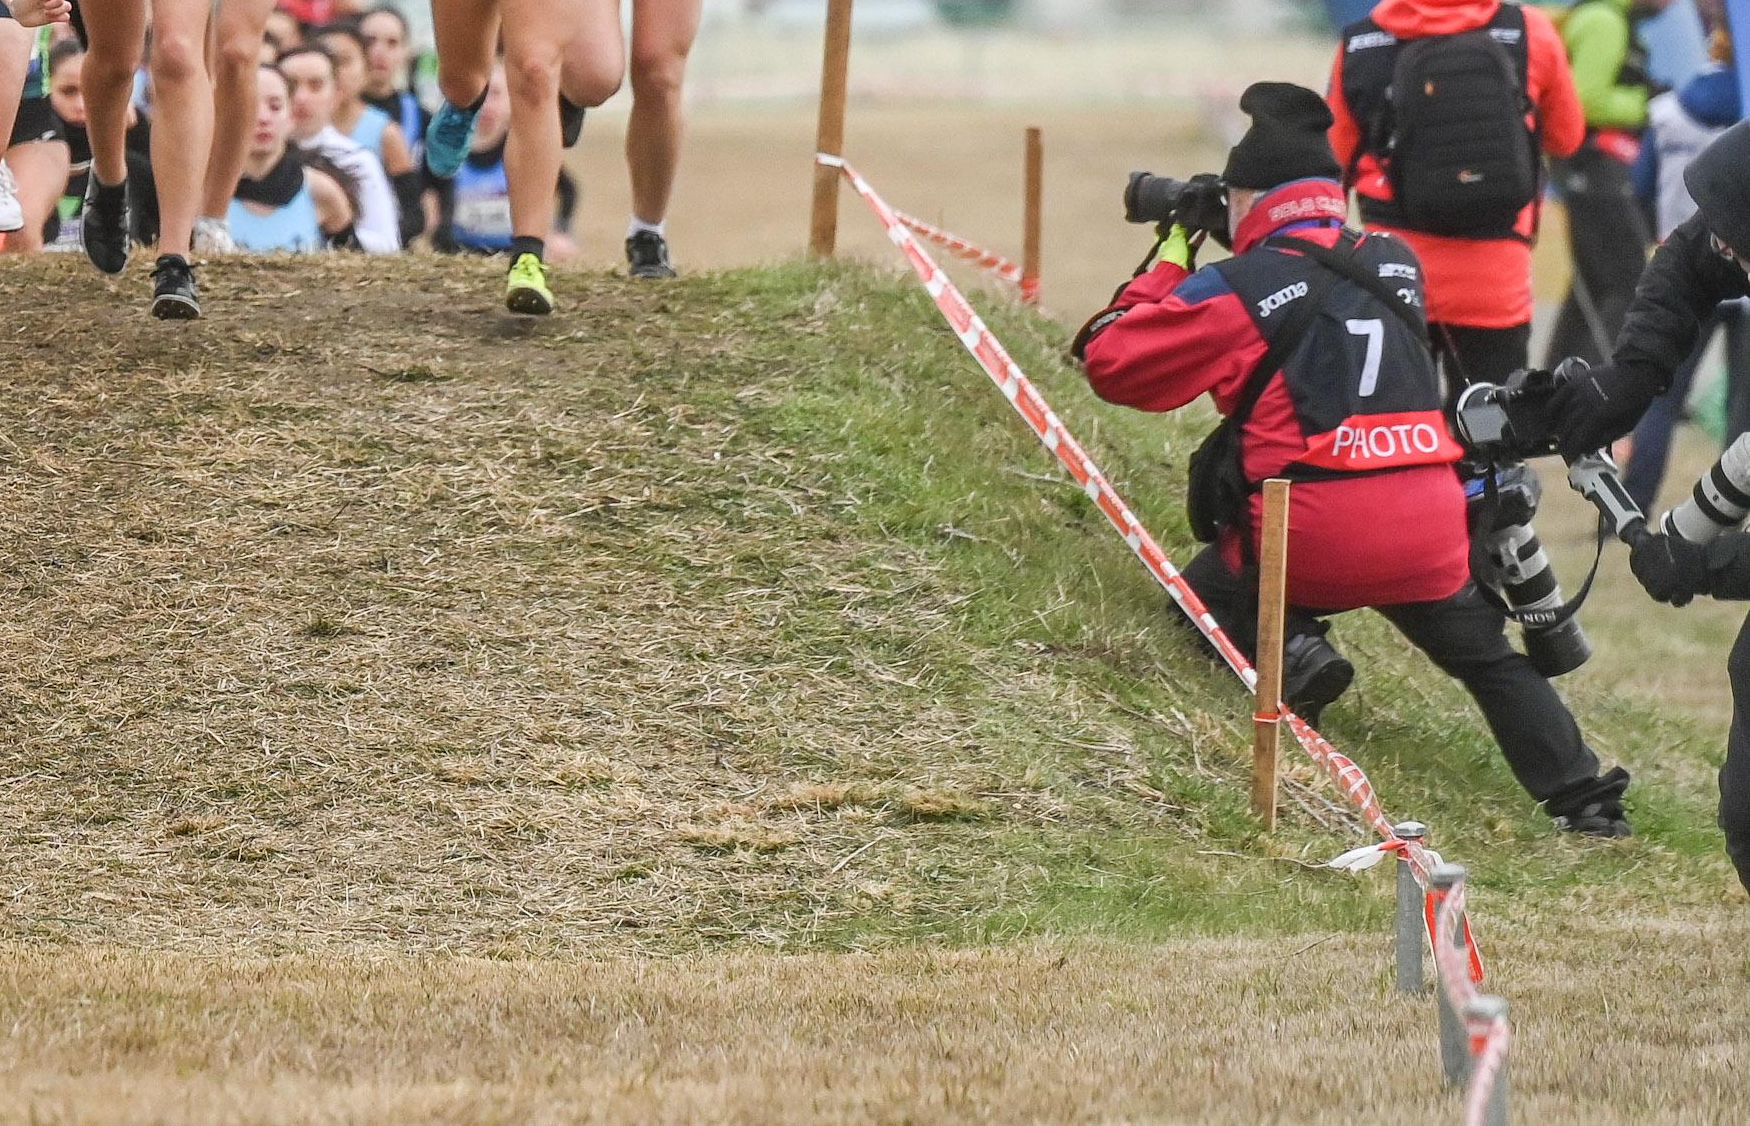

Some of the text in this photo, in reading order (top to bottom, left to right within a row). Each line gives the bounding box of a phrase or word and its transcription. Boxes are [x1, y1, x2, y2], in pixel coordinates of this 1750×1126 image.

[1256, 280, 1310, 318] Joma
[1345, 319, 1384, 397] 7
[1331, 422, 1439, 458] PHOTO
